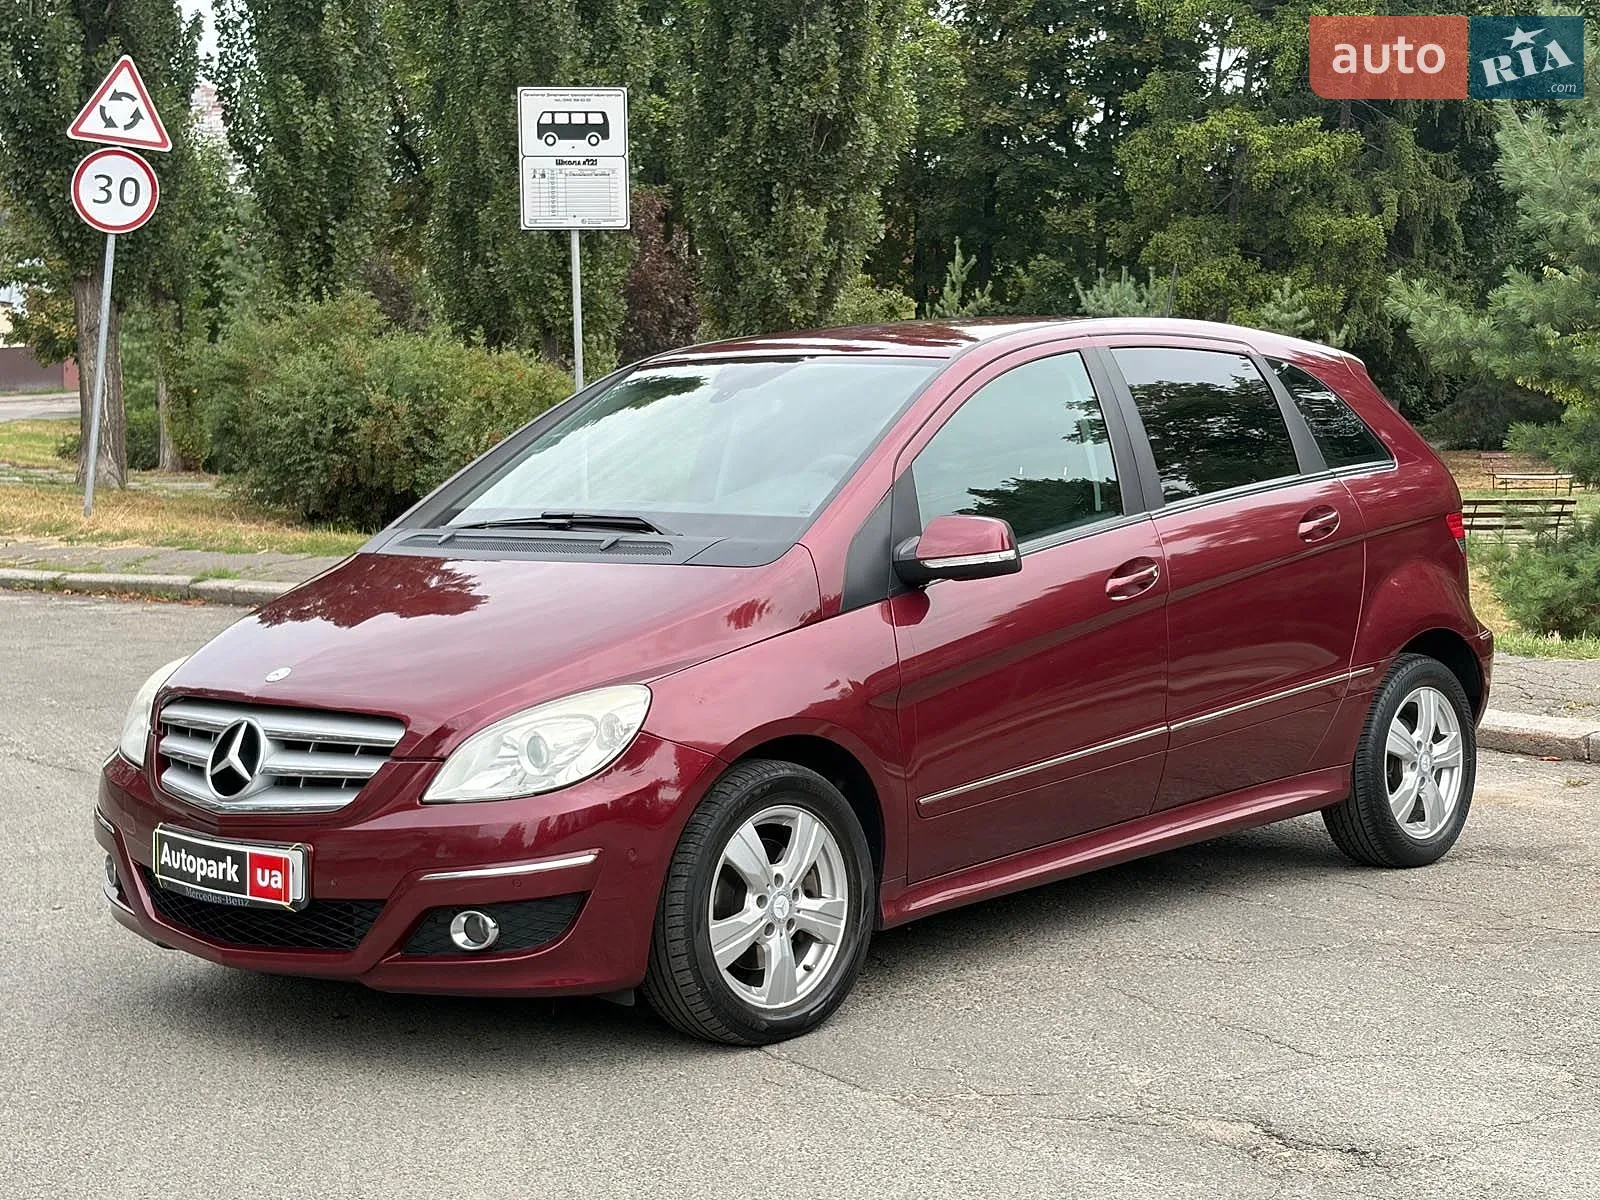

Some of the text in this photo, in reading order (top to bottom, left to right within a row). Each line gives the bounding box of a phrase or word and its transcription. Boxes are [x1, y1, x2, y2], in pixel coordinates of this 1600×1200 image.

[92, 174, 140, 207] 30
[160, 841, 282, 889] Autopark ua
[185, 886, 250, 907] Mercedes-Benz
